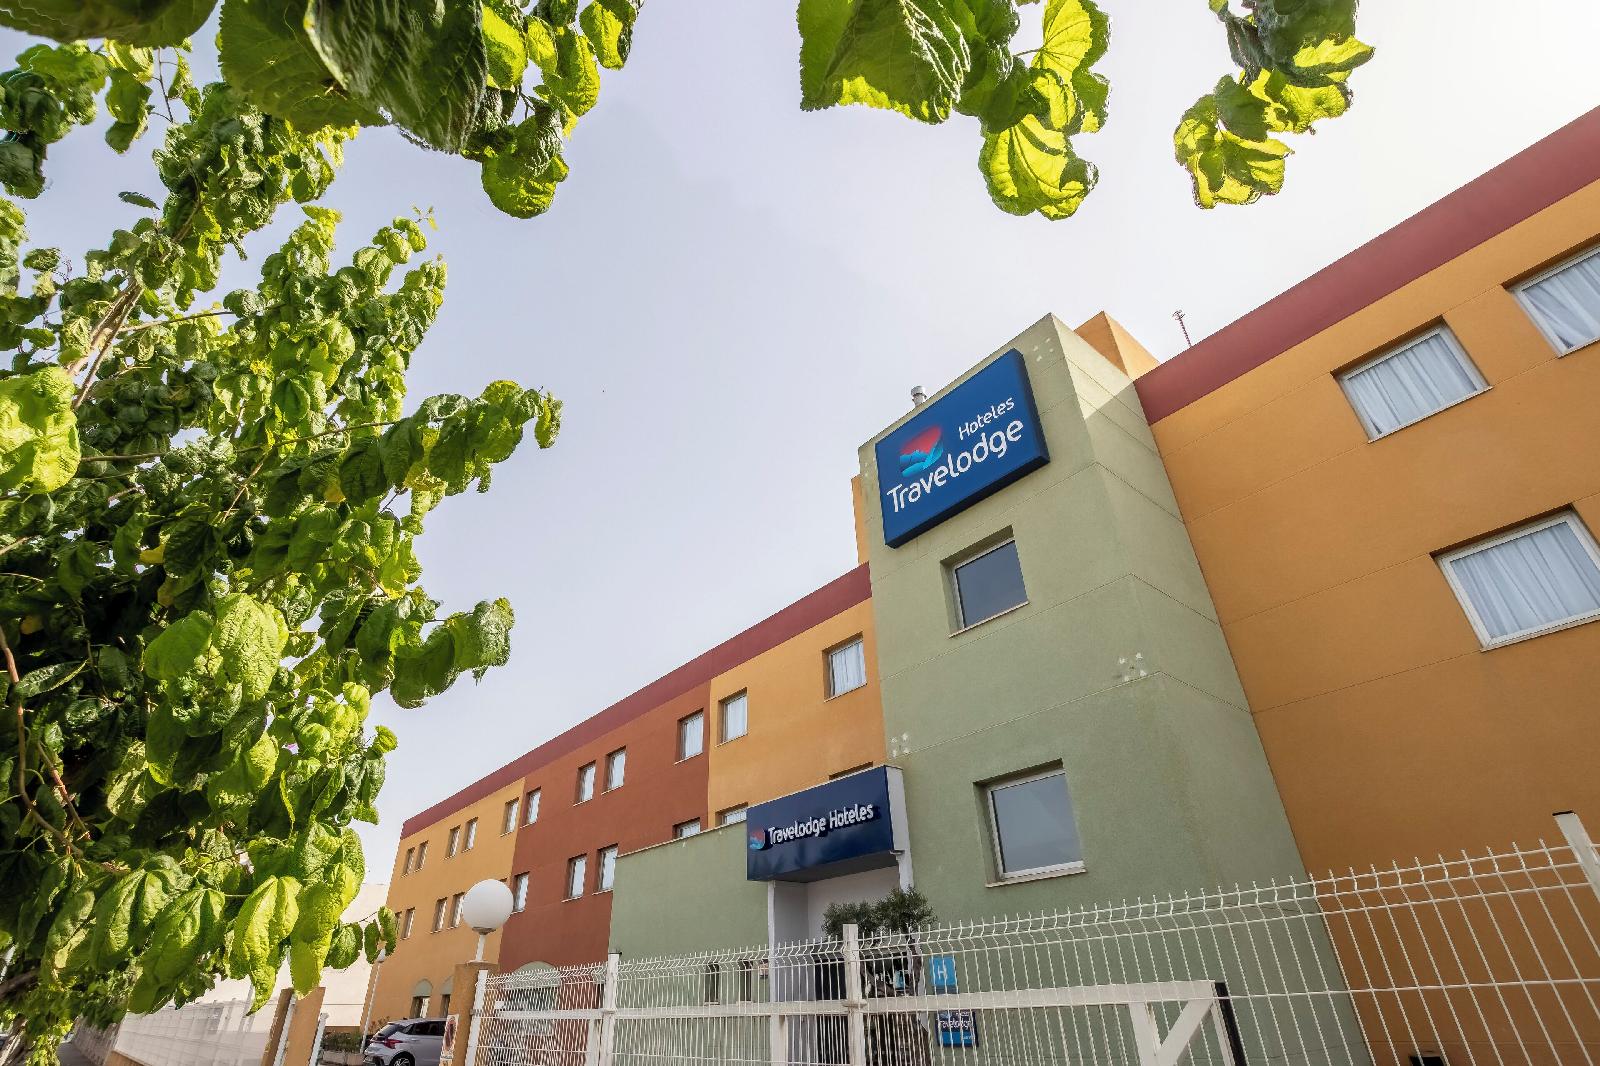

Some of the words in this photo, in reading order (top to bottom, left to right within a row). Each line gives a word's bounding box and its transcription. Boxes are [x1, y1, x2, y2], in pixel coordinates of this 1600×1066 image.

[958, 397, 1015, 441] Hoteles
[886, 420, 1024, 513] Travelodge
[767, 816, 827, 845] Travelodge
[829, 803, 874, 830] Hoteles
[937, 965, 948, 980] H
[936, 1017, 973, 1031] ravelodg
